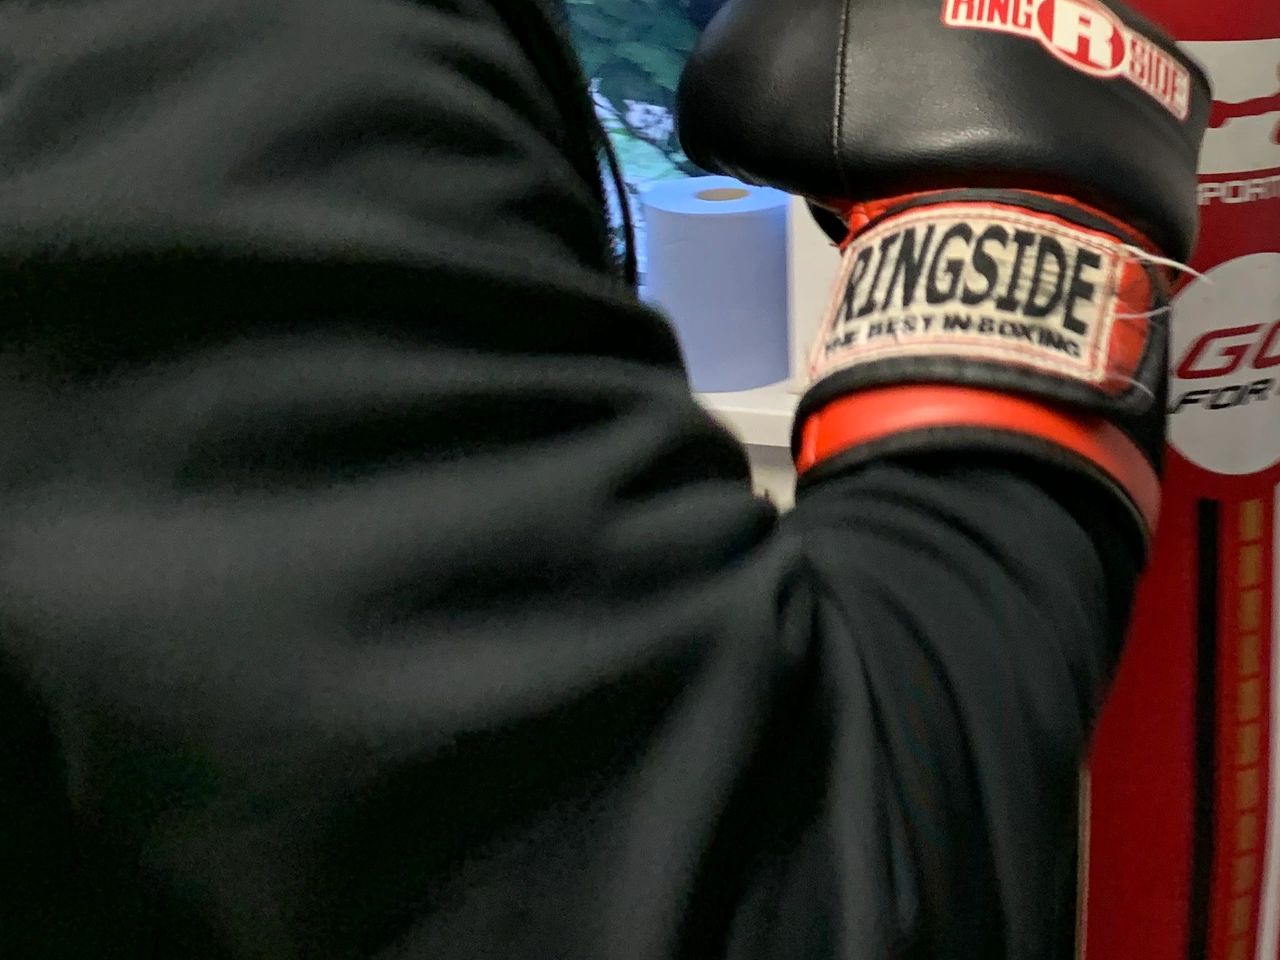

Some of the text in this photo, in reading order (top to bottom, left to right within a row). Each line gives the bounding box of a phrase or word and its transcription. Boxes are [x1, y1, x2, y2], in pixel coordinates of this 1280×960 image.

[1128, 38, 1186, 112] SIDE
[834, 222, 1101, 336] RINGSIDE
[868, 315, 931, 339] BEST
[944, 314, 972, 332] IN
[978, 317, 1081, 359] BOXING
[1168, 378, 1275, 415] FOR
